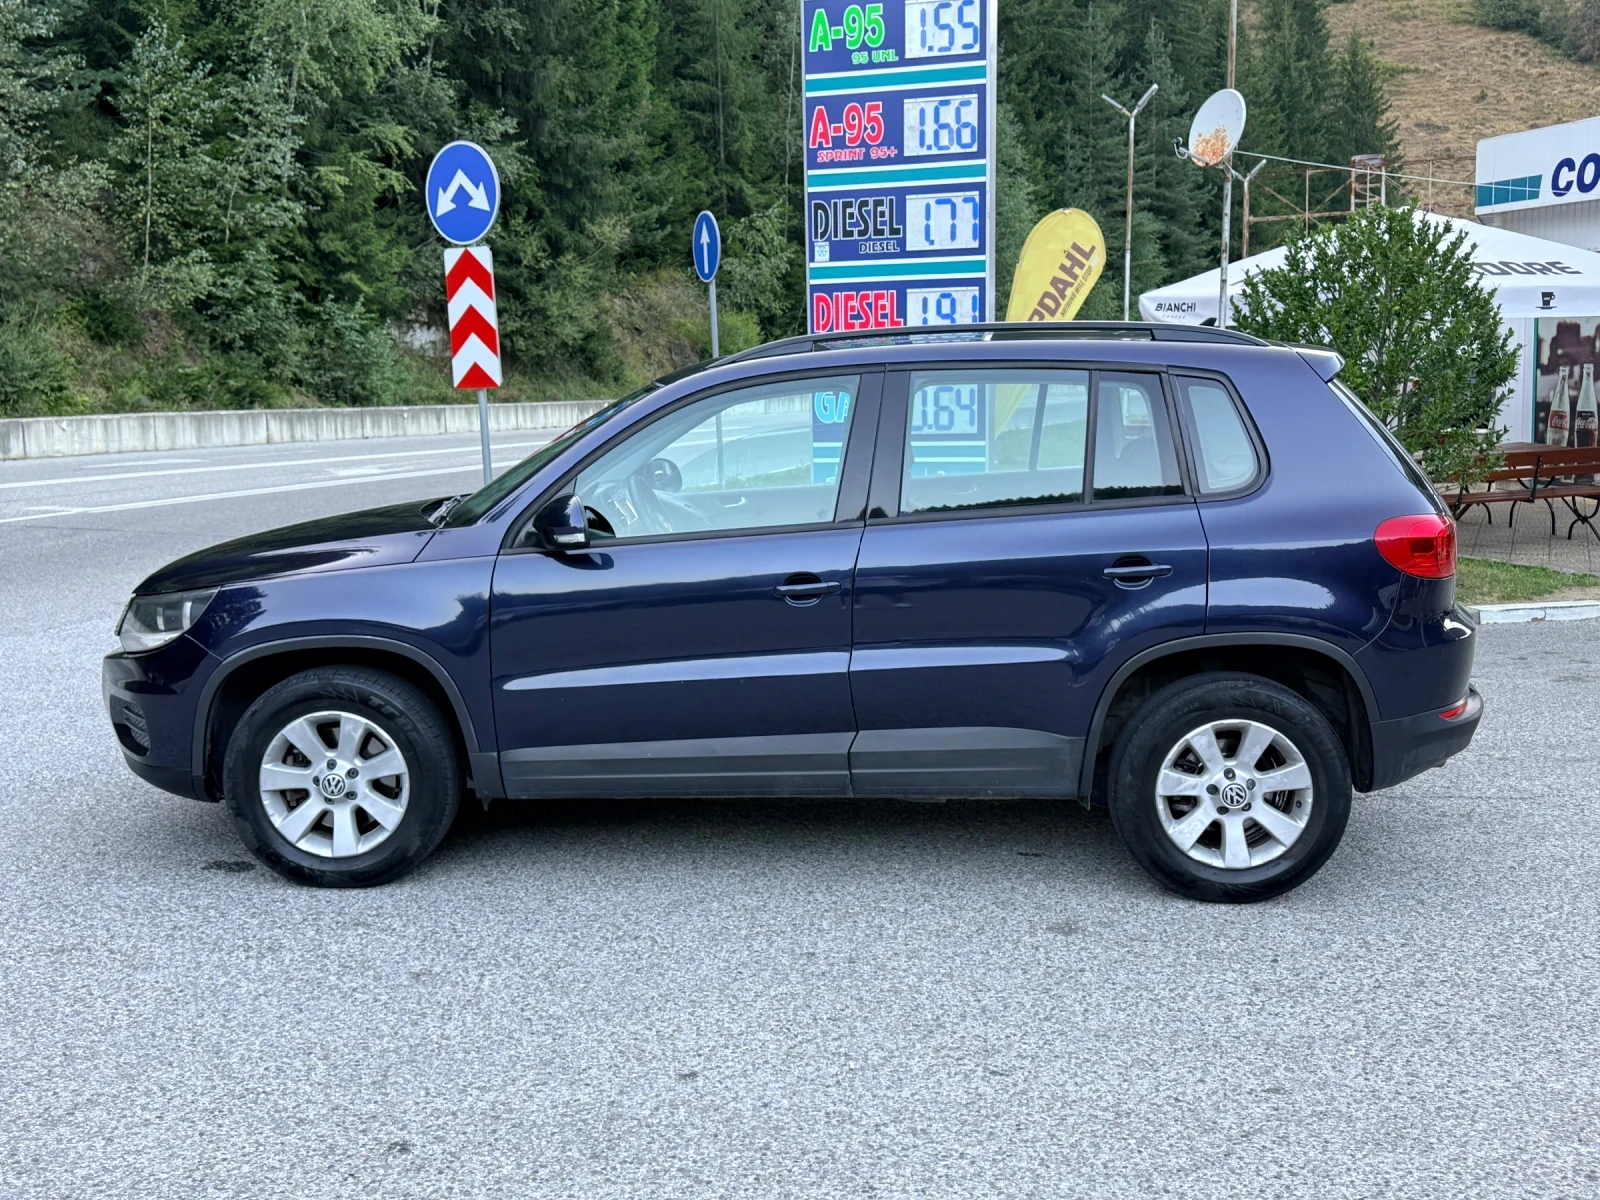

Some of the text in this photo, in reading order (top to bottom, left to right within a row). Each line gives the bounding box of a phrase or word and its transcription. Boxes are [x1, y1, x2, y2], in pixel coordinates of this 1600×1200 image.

[809, 3, 885, 52] A-95
[920, 0, 979, 52] 1.55
[851, 49, 899, 65] 95 UNL
[809, 101, 885, 148] A-95
[919, 99, 977, 151] 1.66
[817, 147, 898, 163] SPRINT 95+
[1551, 152, 1600, 197] CO
[812, 196, 903, 241] DIESEL
[859, 240, 900, 254] DIESEL
[1471, 261, 1584, 276] DORE
[1075, 279, 1085, 294] WILL
[1082, 265, 1093, 282] STOP
[813, 290, 904, 333] DIESEL
[1155, 302, 1197, 312] BIANCHI
